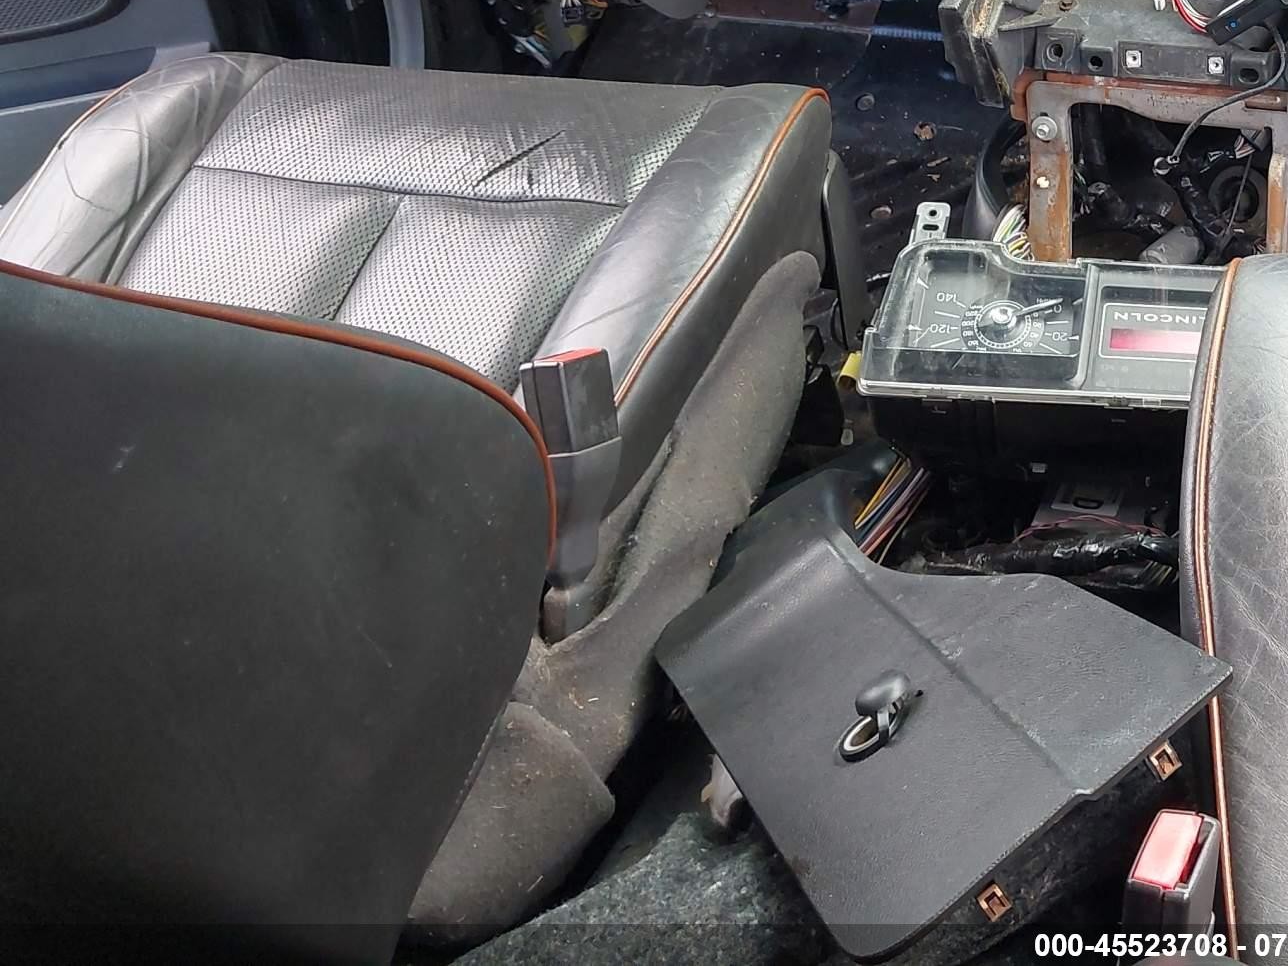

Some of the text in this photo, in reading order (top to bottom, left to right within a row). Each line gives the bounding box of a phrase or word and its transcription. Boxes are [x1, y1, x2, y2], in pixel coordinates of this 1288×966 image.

[936, 292, 957, 303] 140
[930, 323, 950, 334] 120
[1052, 331, 1068, 342] 20
